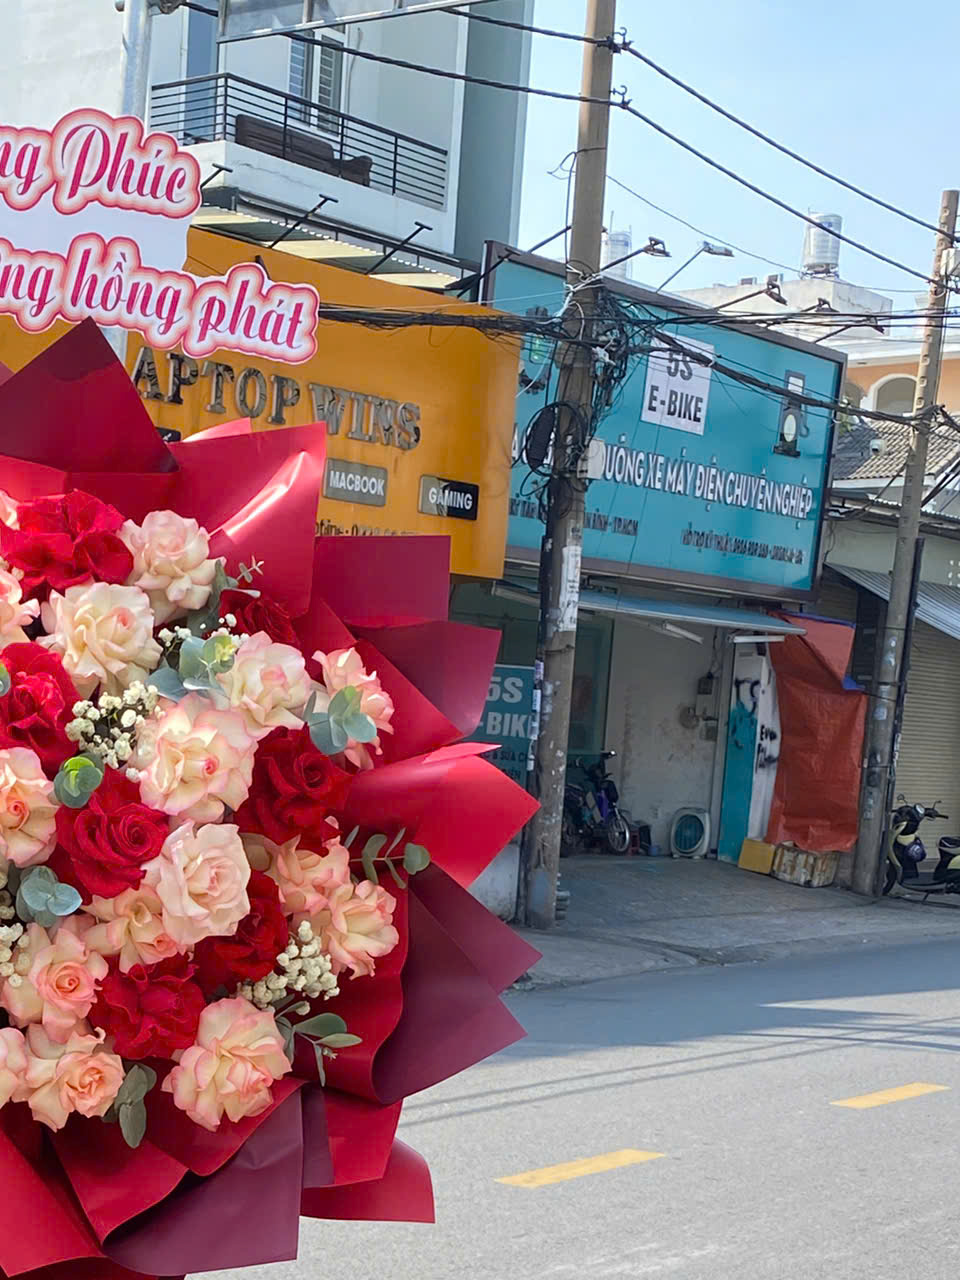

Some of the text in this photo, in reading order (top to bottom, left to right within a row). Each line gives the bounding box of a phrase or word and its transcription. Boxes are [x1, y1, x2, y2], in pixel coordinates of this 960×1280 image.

[61, 123, 187, 203] Phúc
[70, 247, 183, 335] hồng
[197, 281, 304, 349] phát
[130, 346, 300, 425] APTOP
[329, 470, 385, 497] MACBOOK
[428, 487, 473, 510] GAMING
[646, 453, 665, 490] XE
[725, 467, 773, 512] CHUYÊN
[480, 712, 537, 739] -BIK
